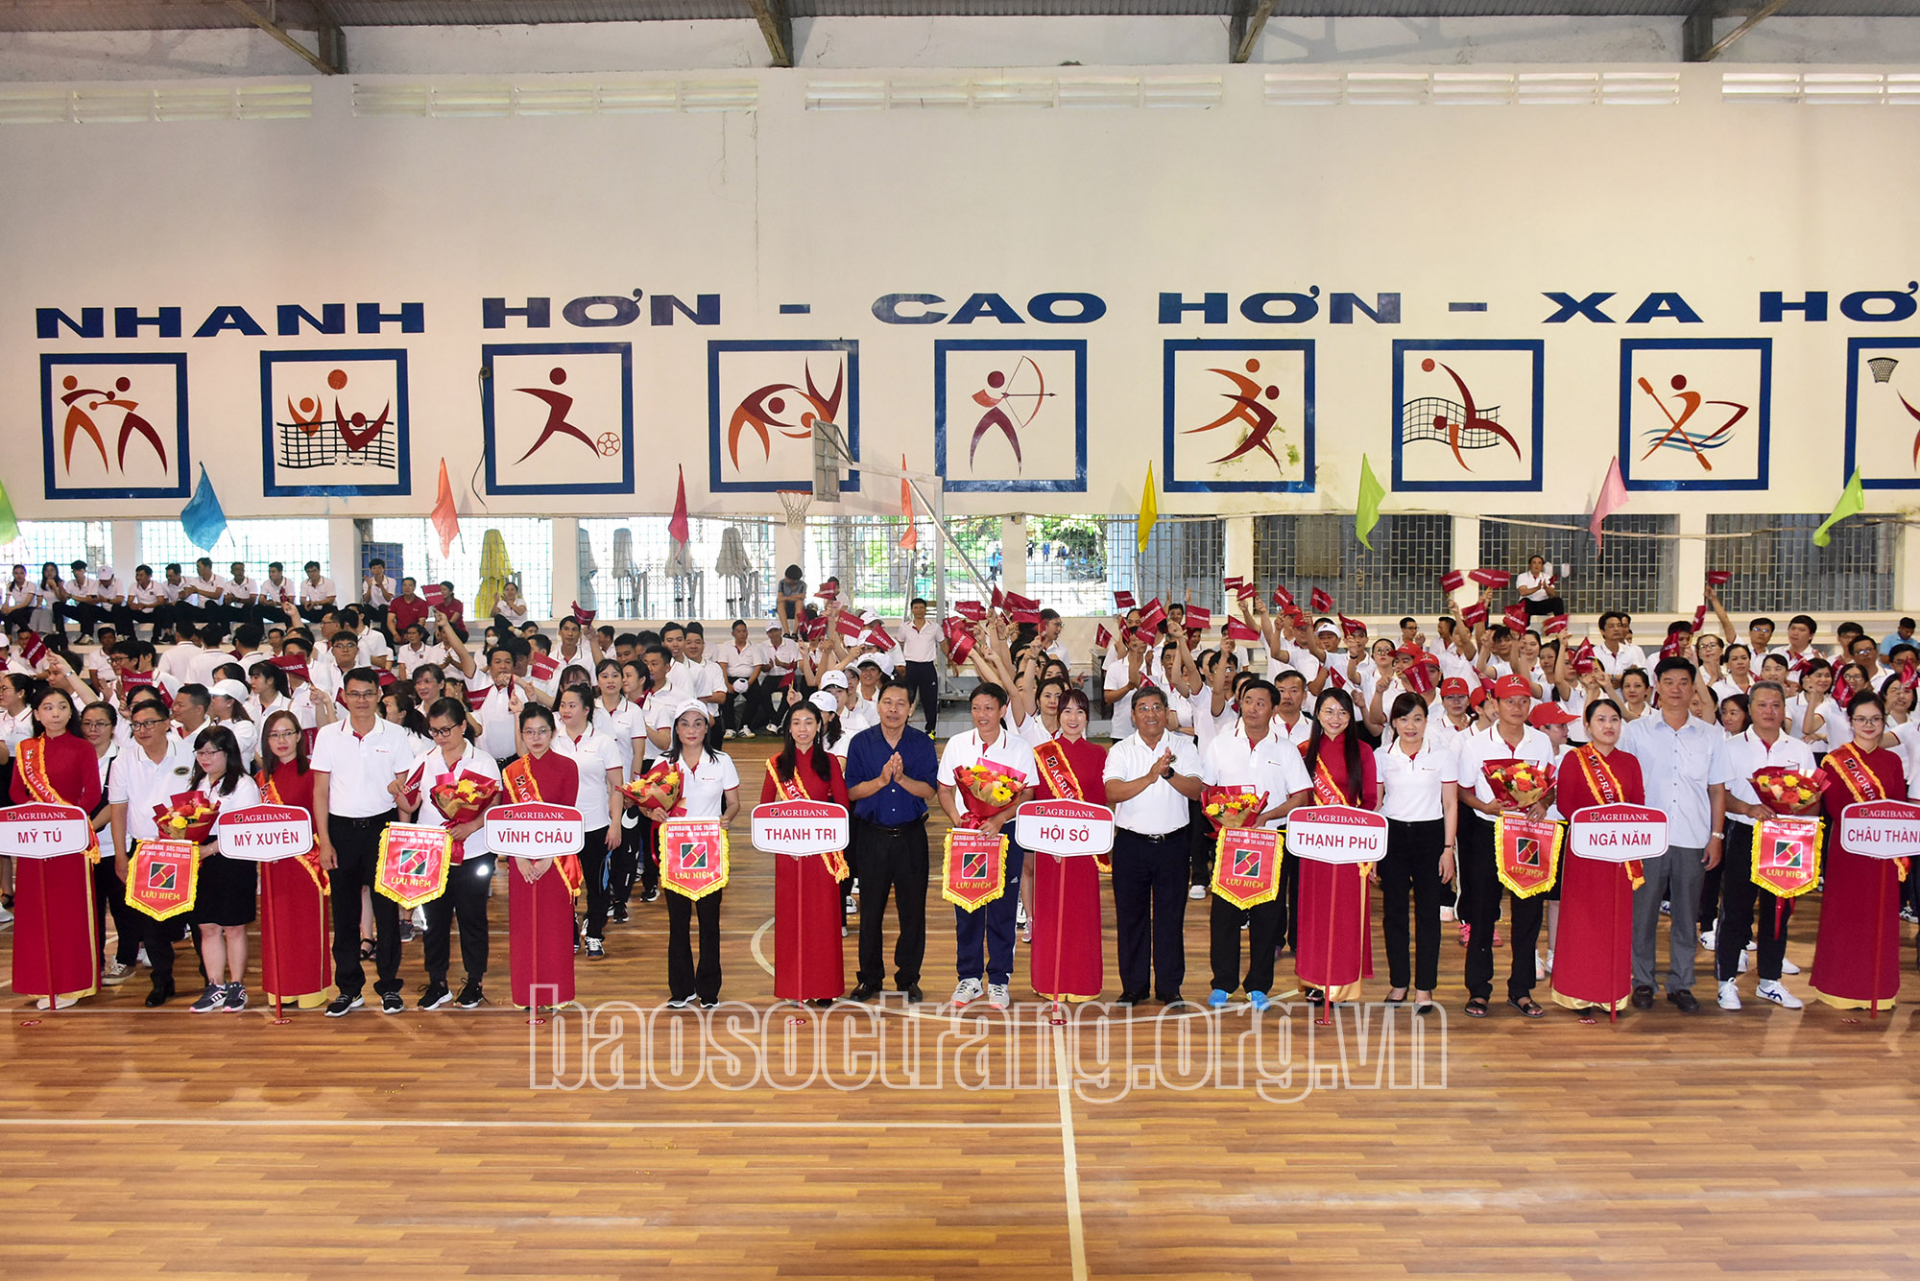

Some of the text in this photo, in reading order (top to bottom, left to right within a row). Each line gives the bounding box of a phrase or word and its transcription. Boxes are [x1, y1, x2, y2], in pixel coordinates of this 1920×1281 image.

[38, 304, 424, 339] NHANH
[483, 288, 721, 329] HƠN
[779, 303, 811, 314] -
[872, 292, 1107, 325] CAO
[1158, 284, 1402, 324] HƠN
[1449, 302, 1487, 312] -
[1542, 292, 1704, 323] XA
[18, 811, 67, 820] AGRIBANK
[244, 812, 292, 822] AGRIBANK
[780, 809, 829, 817] AGRIBANK
[1045, 808, 1095, 818] AGRIBANK
[1316, 814, 1368, 825] AGRIBANK
[1600, 813, 1649, 821] AGRIBANK
[1868, 810, 1915, 818] AGRIBANK
[18, 828, 62, 843] MỸ TÚ
[234, 828, 299, 846] MỸ XUYÊN
[498, 827, 573, 844] VĨNH CHÂU
[765, 828, 837, 843] THẠNH TRỊ
[1041, 824, 1090, 842] HỘI SỞ
[1589, 830, 1652, 846] NGÃ NĂM
[1847, 826, 1920, 843] CHÂU THÀN
[1297, 832, 1378, 850] THẠNH PHÚ
